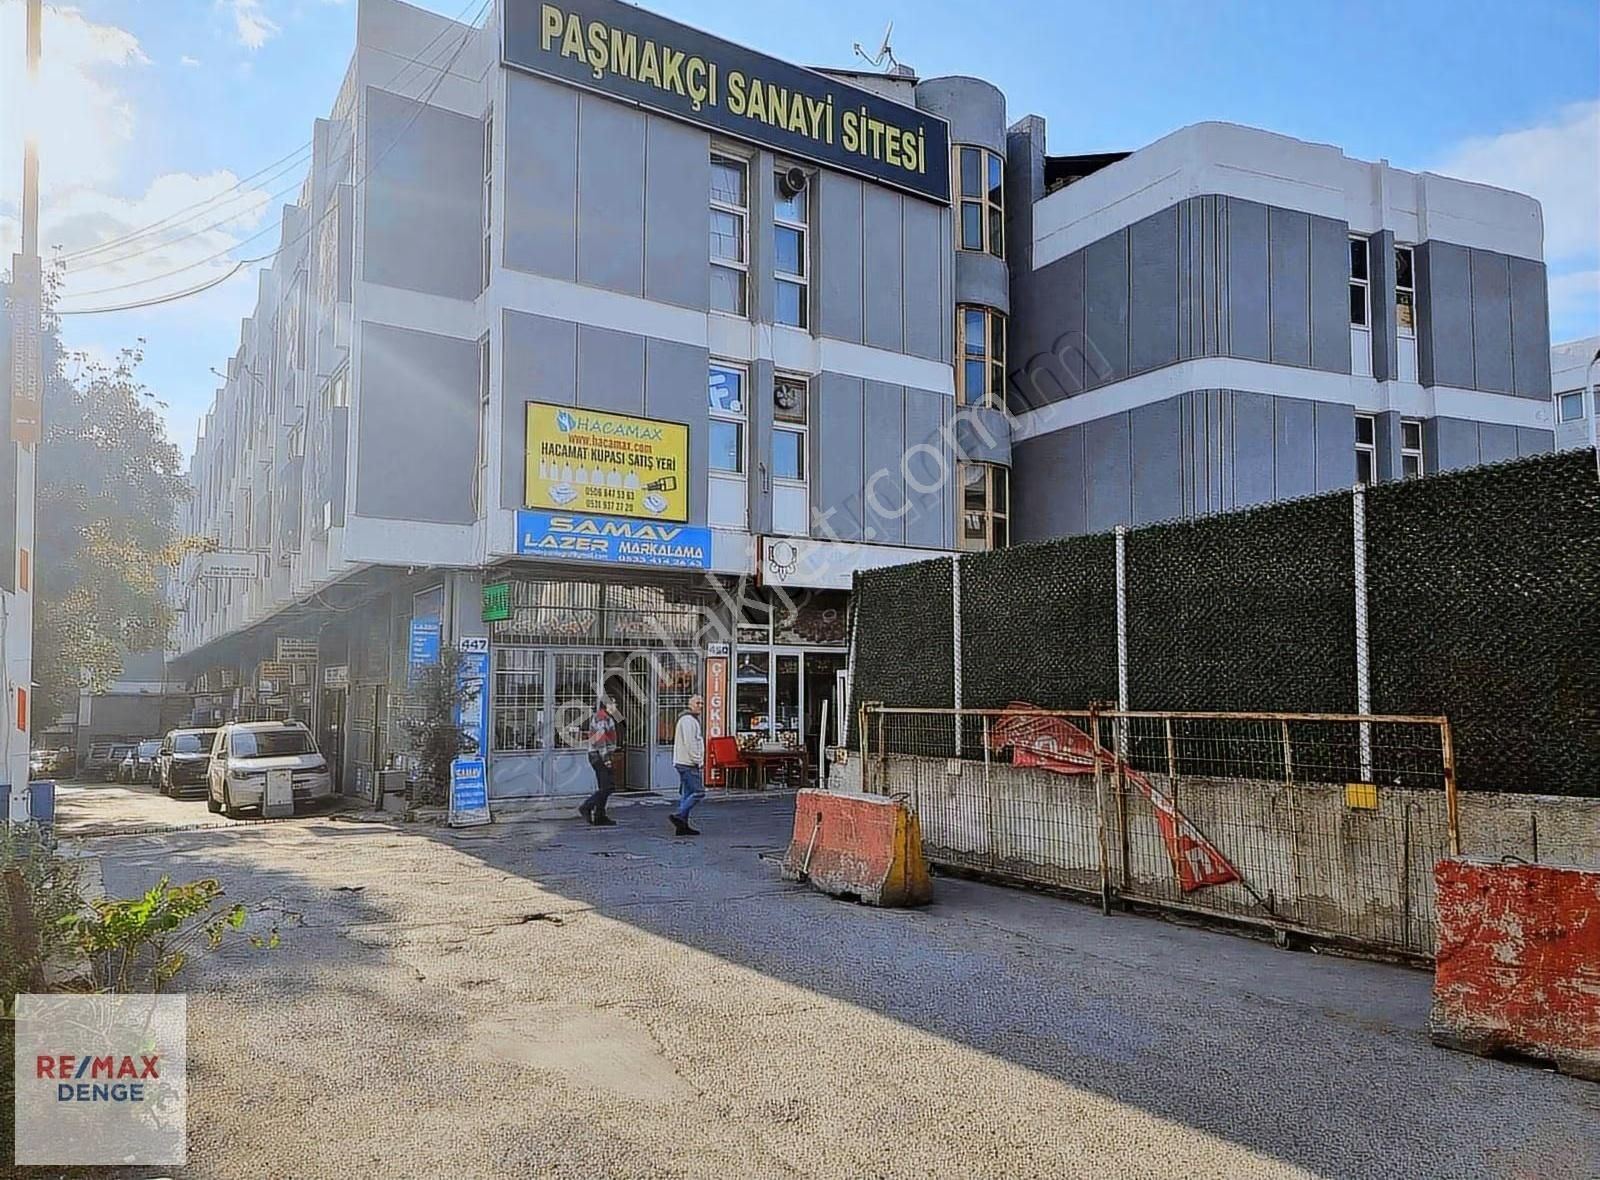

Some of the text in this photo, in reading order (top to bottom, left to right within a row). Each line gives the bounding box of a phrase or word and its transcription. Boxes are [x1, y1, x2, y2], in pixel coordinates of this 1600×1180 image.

[541, 4, 925, 174] PAŞMAKÇI SANAYİ SİTESİ
[577, 417, 662, 441] HACAMAX
[568, 434, 652, 453] www.hacamax.com
[542, 442, 676, 472] HACAMAT KUPASI SATIŞ YERİ
[549, 516, 682, 541] SAMAV
[524, 534, 609, 552] LAZER
[618, 541, 703, 559] MARKALAMA
[462, 639, 487, 650] 447
